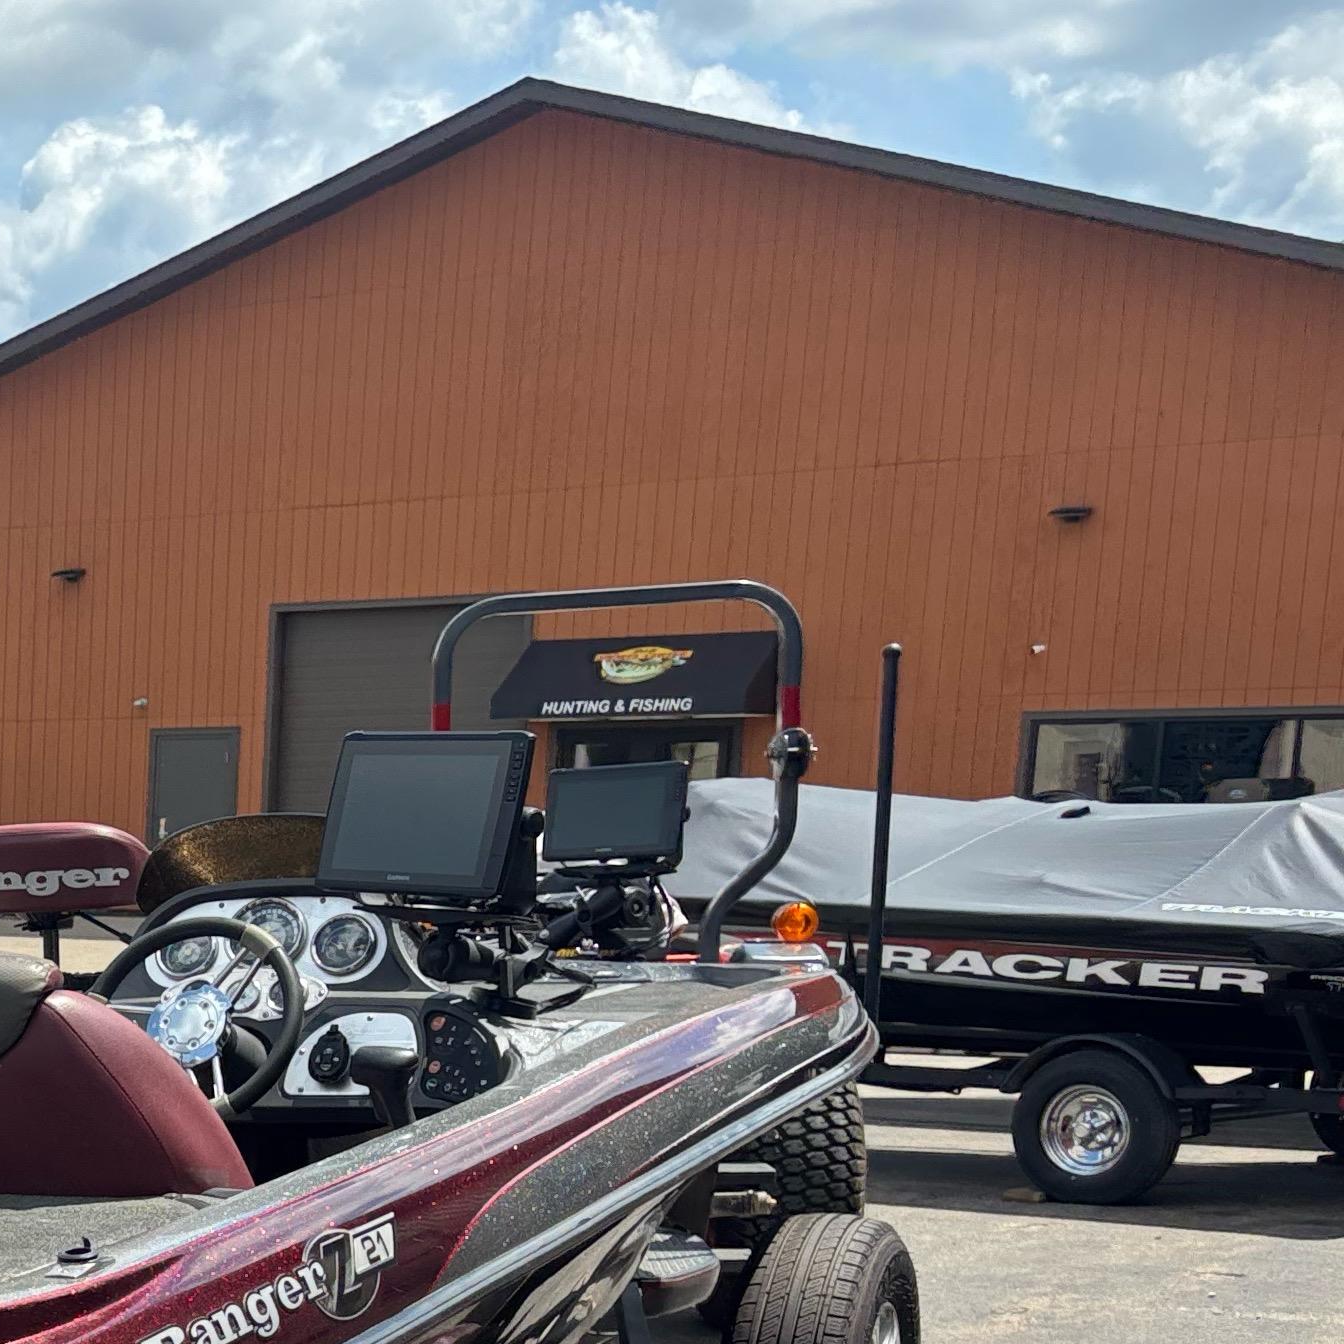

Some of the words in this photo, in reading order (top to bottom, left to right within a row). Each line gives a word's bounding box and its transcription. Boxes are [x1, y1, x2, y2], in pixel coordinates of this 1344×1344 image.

[541, 700, 611, 715] HUNTING
[614, 699, 626, 713] &
[629, 697, 693, 713] FISHING
[826, 940, 1269, 995] TRACKER
